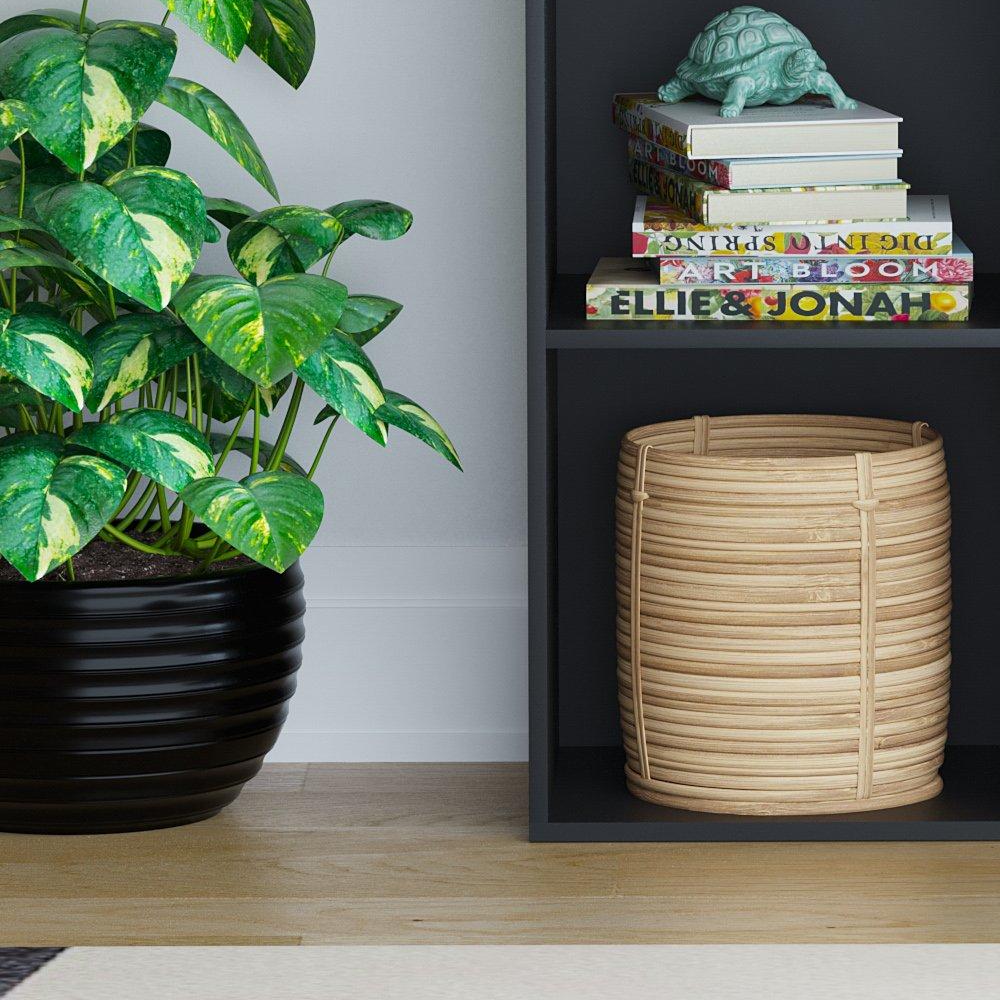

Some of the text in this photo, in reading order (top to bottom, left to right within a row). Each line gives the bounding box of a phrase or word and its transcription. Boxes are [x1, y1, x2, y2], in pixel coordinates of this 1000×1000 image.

[670, 153, 718, 180] BLOOM
[664, 233, 934, 252] DIG INTO SPRING
[679, 262, 939, 281] ART BLOOM
[611, 290, 931, 317] ELLIE & JONAH
